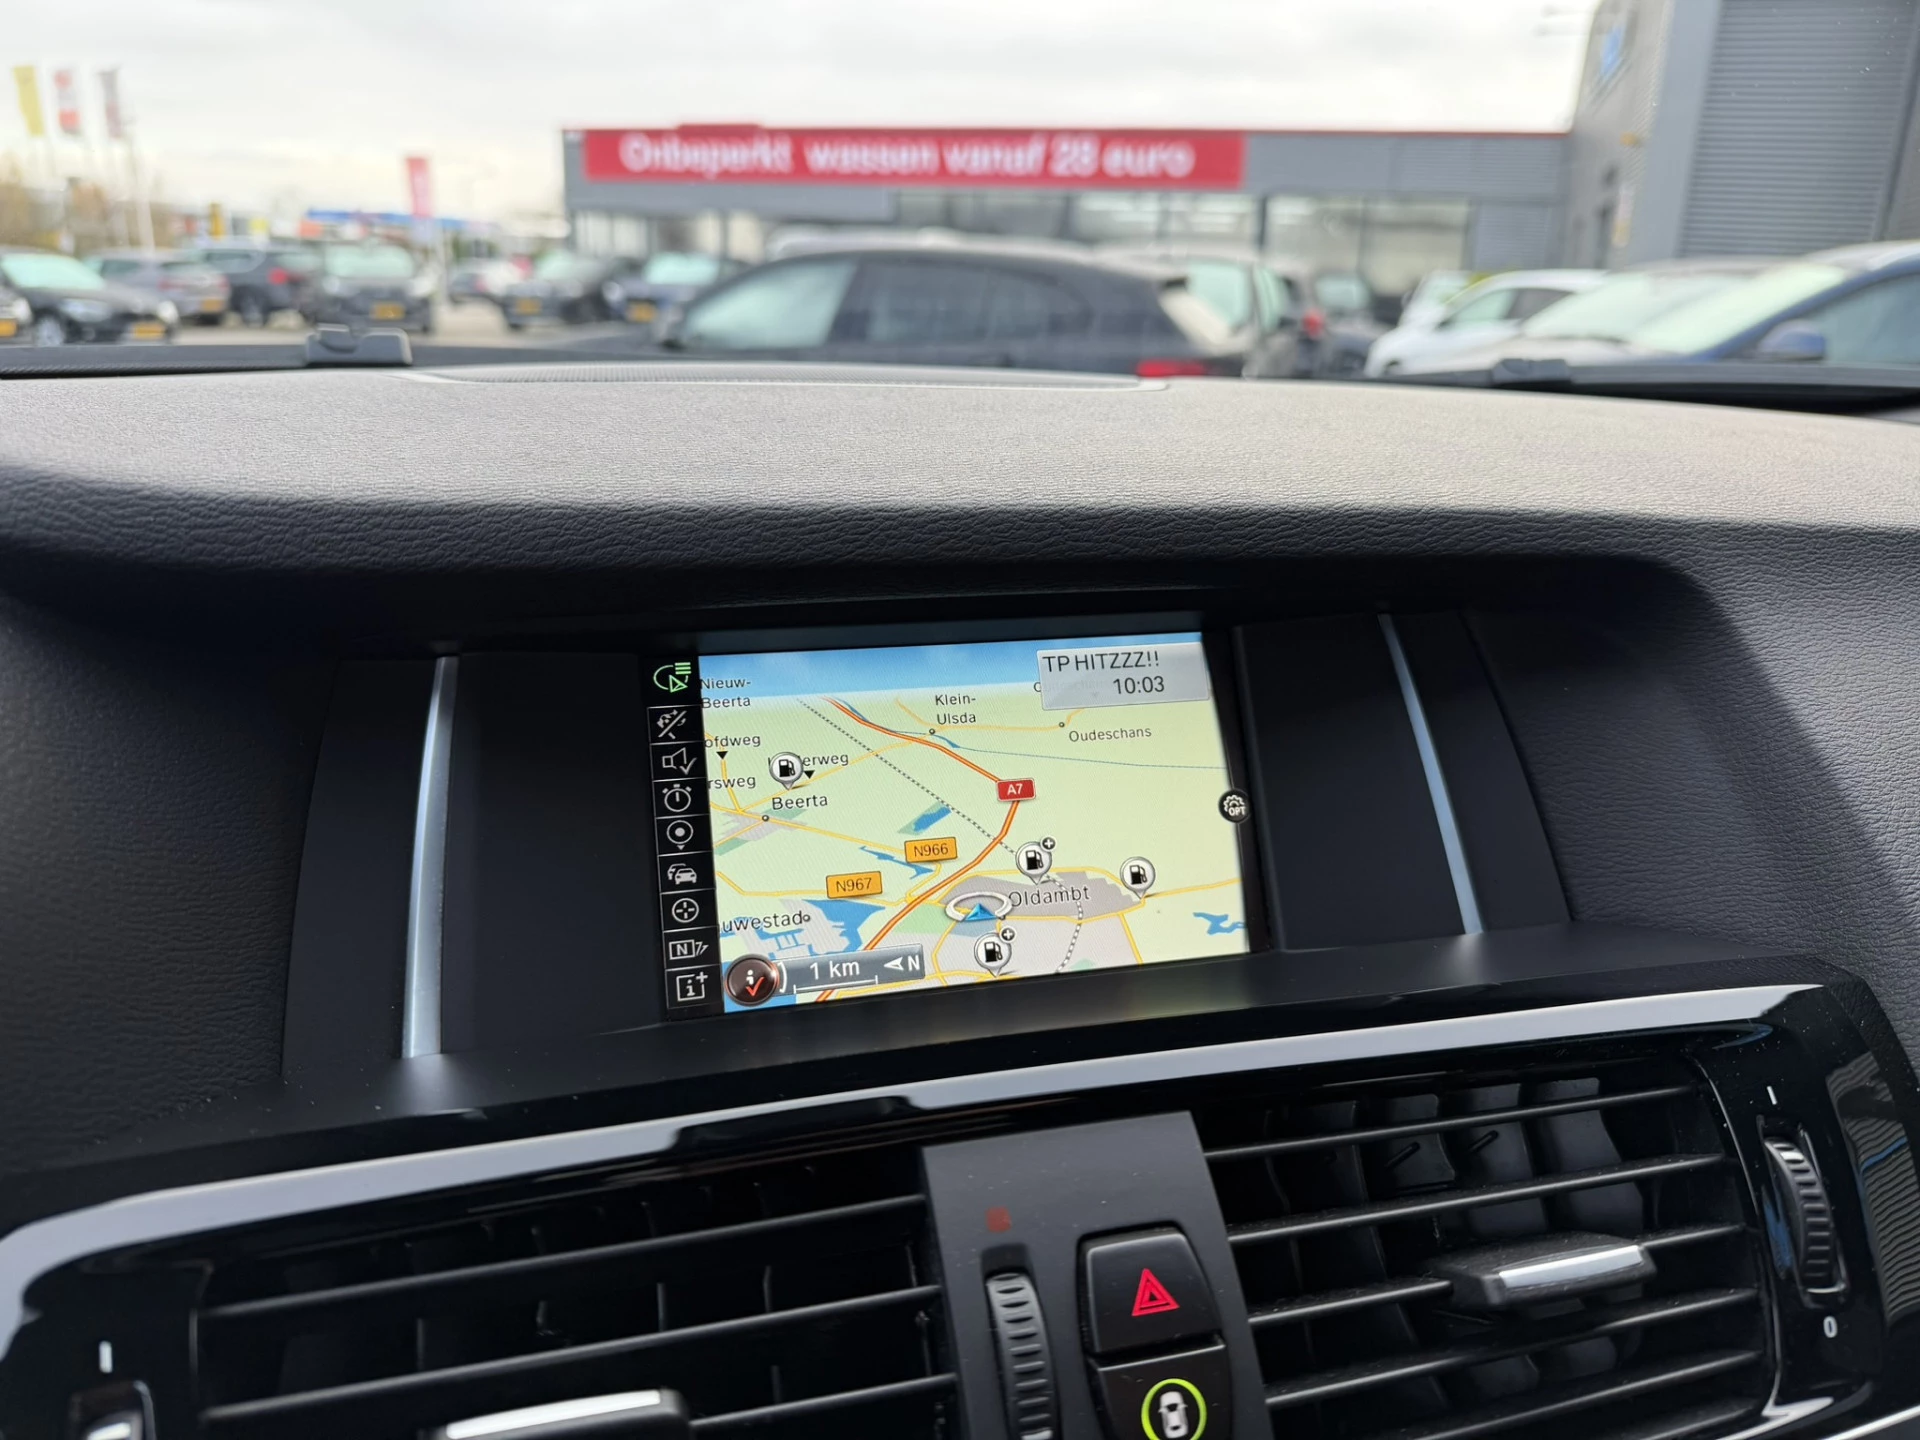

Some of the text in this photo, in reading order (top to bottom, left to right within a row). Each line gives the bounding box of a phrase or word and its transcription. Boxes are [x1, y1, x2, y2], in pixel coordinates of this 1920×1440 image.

[619, 132, 1195, 180] Onbeperkt wassen vanaf 28 euro
[1042, 650, 1160, 673] TP HITZZZ!!
[700, 678, 751, 690] Nieuw-
[1113, 675, 1165, 695] 10:03
[702, 696, 751, 709] Beerta
[935, 691, 977, 706] Klein-
[937, 711, 977, 726] Ulsda
[1068, 727, 1152, 743] Oudeschans
[1006, 784, 1024, 796] A7
[772, 794, 829, 811] Beerta
[1228, 805, 1246, 817] OPT
[913, 841, 950, 857] N966
[835, 876, 874, 893] N967
[1007, 885, 1090, 908] Oldambt
[719, 910, 803, 933] uwestad
[810, 960, 860, 980] 1 km
